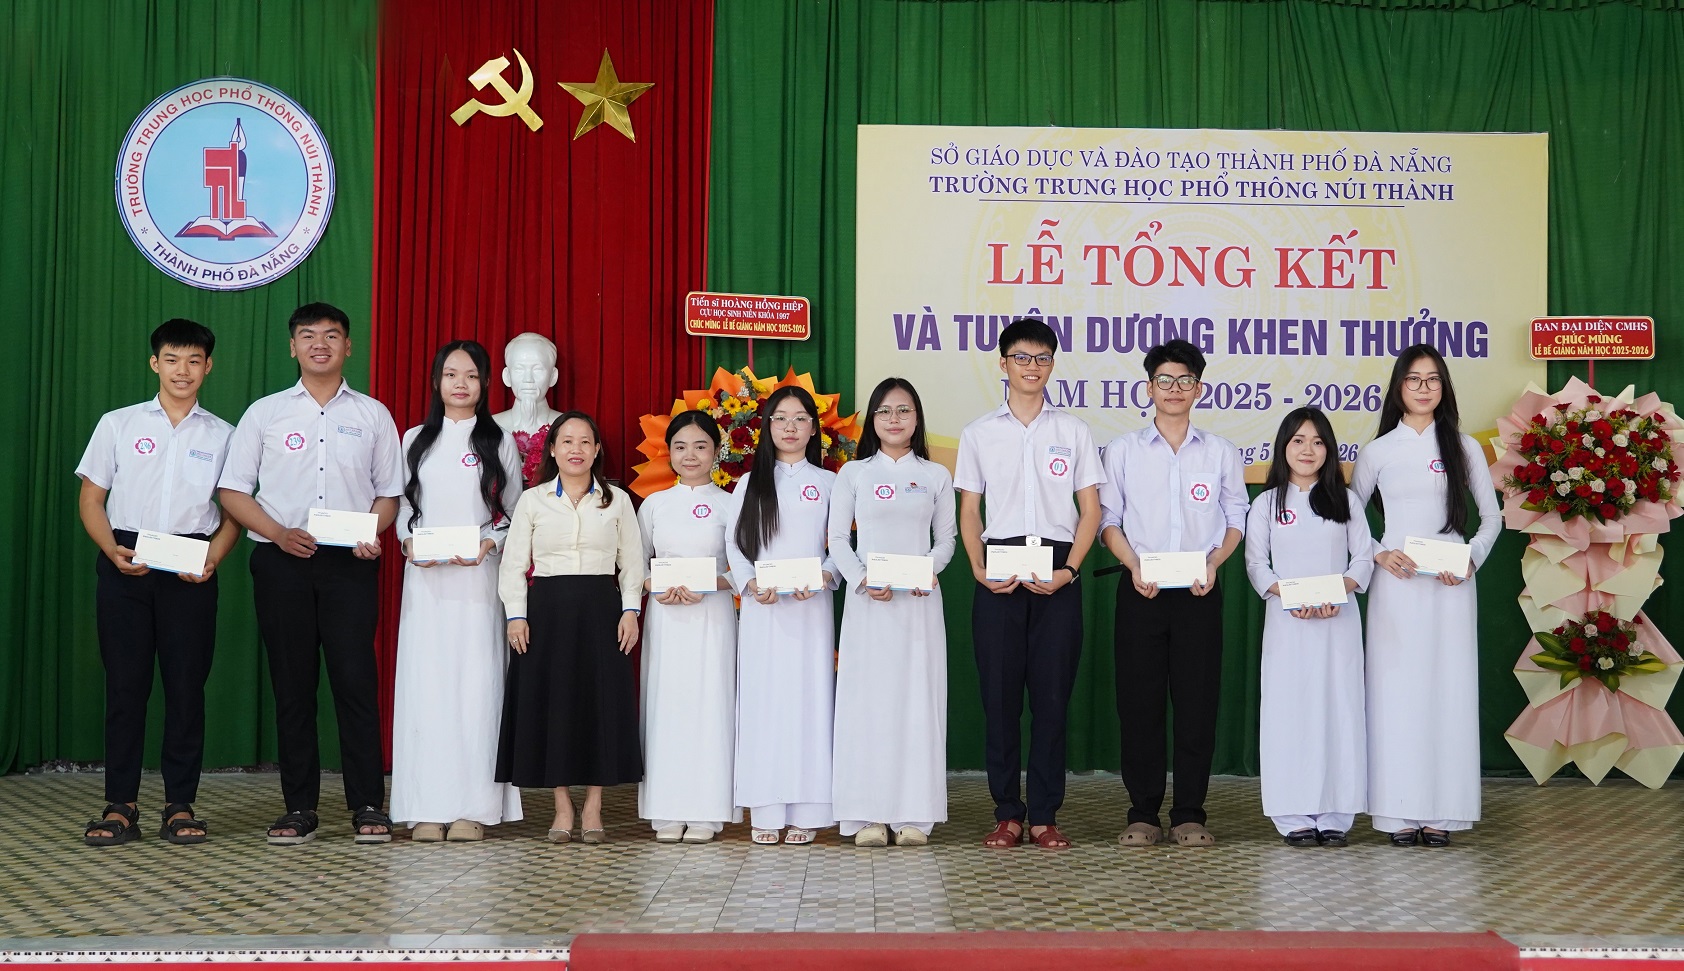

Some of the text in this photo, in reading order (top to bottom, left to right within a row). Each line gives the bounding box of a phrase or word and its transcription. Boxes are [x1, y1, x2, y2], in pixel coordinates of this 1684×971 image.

[125, 85, 326, 217] TRƯỜNG TRUNG HỌC PHỔ THÔNG NÚI THÀNH
[931, 142, 1452, 174] SỞ GIÁO DỤC VÀ ĐÀO TẠO THÀNH PHỐ ĐÀ NẴNG
[929, 170, 1454, 201] TRƯỜNG TRUNG HỌC PHỔ THÔNG NÚI THÀNH
[153, 241, 300, 281] THÀNH PHỐ ĐÀ NẴNG
[987, 219, 1396, 290] LỄ TỔNG KẾT
[690, 296, 710, 307] Tiến
[721, 297, 753, 309] HOÀNG
[782, 300, 804, 313] HIỆP
[727, 309, 741, 318] SINH
[776, 312, 790, 320] 1997
[690, 318, 704, 329] CHÚC
[778, 323, 806, 333] 2025-2026
[893, 306, 1488, 358] VÀ TUN DƯƠNG KHEN THƯỞNG
[1534, 319, 1648, 333] BAN ĐẠI DIỆN CMHS
[1554, 332, 1623, 344] CHÚC MỪNG
[1552, 344, 1576, 355] GIẢNG
[1577, 345, 1594, 355] NĂM
[1595, 346, 1611, 356] HỌC
[1612, 345, 1649, 355] 2025-2026
[1101, 380, 1155, 417] HỌ
[1195, 382, 1272, 410] 2025
[1304, 383, 1382, 412] 2026
[1259, 442, 1271, 461] 5
[1339, 443, 1359, 462] 26
[1054, 462, 1063, 472] 01
[880, 488, 890, 496] 03
[1195, 488, 1205, 497] 46
